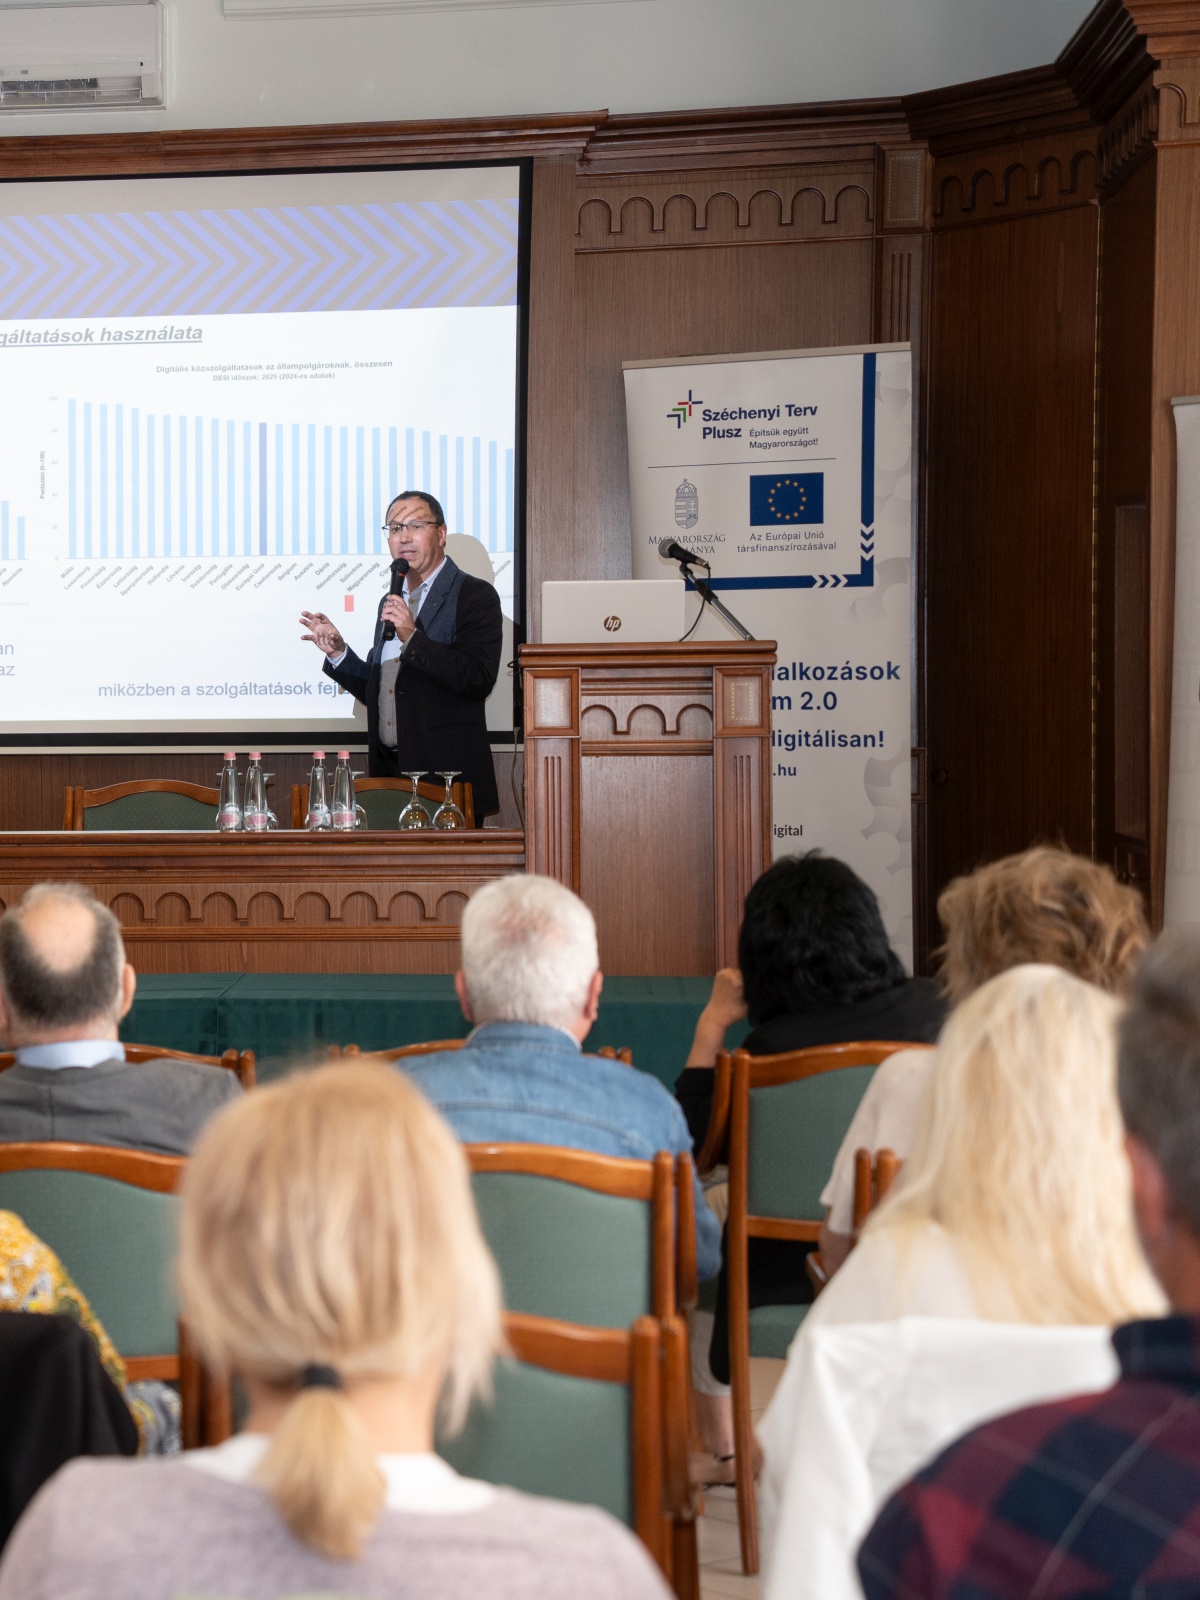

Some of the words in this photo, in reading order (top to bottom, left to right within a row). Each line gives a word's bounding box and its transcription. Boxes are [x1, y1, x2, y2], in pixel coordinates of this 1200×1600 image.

[100, 326, 203, 342] használata
[156, 364, 189, 374] Digitális
[191, 363, 264, 373] közszolgáltatások
[354, 360, 393, 368] összesen
[702, 405, 780, 422] Széchenyi
[785, 404, 818, 417] Terv
[702, 426, 742, 439] Plusz
[750, 428, 780, 438] Építsük
[783, 427, 809, 437] együtt
[750, 438, 818, 450] Magyarországot!
[750, 533, 762, 541] Az
[766, 532, 801, 542] Európai
[804, 531, 824, 540] Unió
[686, 545, 716, 554] ÁNYA
[738, 542, 837, 553] társfinanszírozásával
[61, 566, 75, 580] Málta
[277, 562, 298, 582] Belgium
[315, 562, 330, 576] Dánia
[605, 616, 621, 632] hp
[772, 660, 901, 681] lalkozások
[98, 683, 175, 697] miközben
[180, 686, 190, 696] a
[196, 682, 312, 698] szolgáltatások
[772, 695, 792, 710] m
[800, 691, 837, 710] 2.0
[772, 729, 884, 752] igitálisan!
[773, 764, 797, 776] .hu
[774, 824, 803, 838] igital
